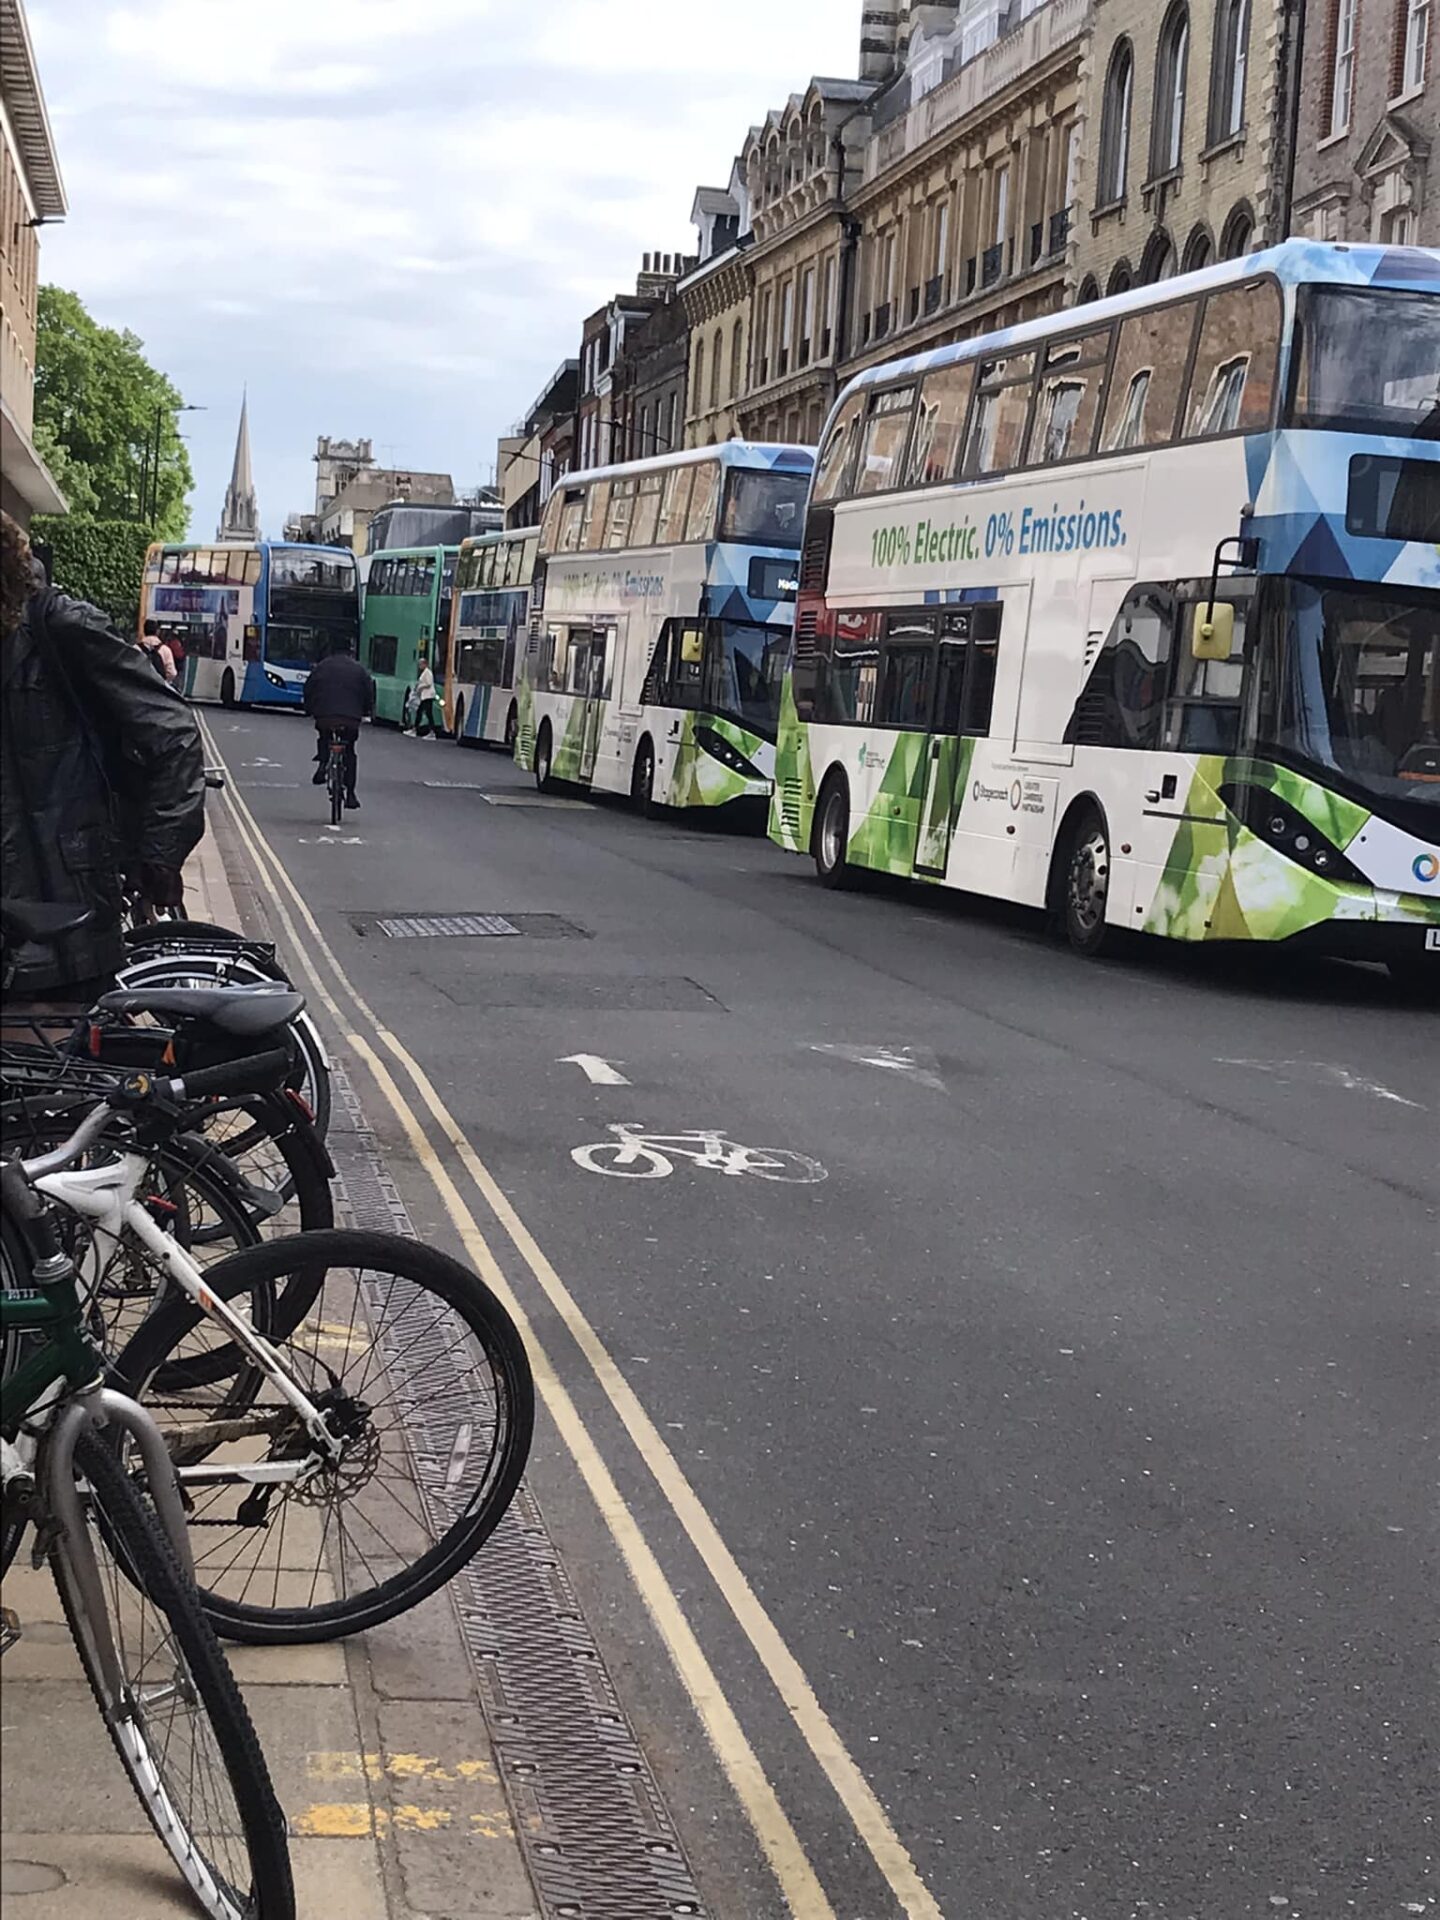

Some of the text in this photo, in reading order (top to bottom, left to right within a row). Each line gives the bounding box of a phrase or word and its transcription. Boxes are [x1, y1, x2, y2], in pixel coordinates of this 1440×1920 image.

[871, 499, 1127, 568] 100% Electric. 0% Emissions.
